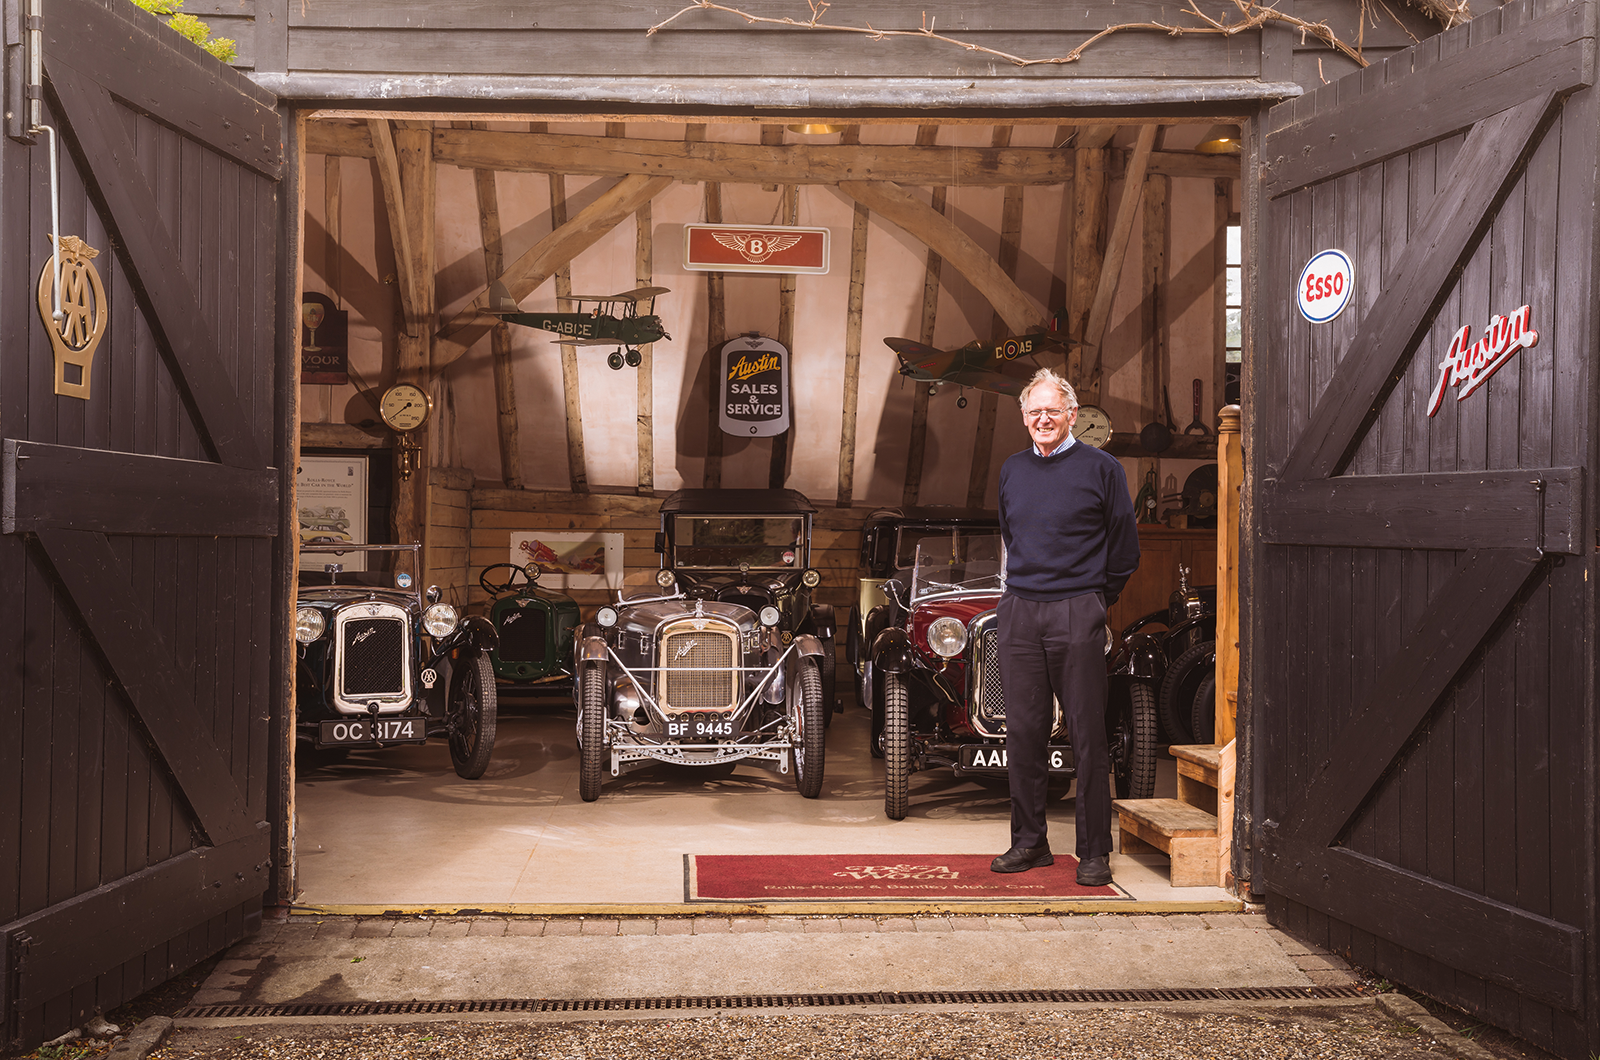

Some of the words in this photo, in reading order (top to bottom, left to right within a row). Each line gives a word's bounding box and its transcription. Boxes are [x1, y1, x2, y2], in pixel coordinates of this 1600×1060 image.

[750, 240, 763, 254] B
[1305, 271, 1344, 302] ESSO
[1019, 340, 1033, 355] AS
[301, 355, 340, 365] VOUR
[728, 353, 781, 381] Austin
[1427, 304, 1539, 418] Austin
[731, 383, 778, 395] SALES
[749, 395, 759, 404] &
[727, 403, 781, 416] SERVICE
[332, 722, 363, 741] OC
[369, 720, 414, 740] 3174
[668, 723, 689, 736] BF
[696, 722, 733, 735] 9445
[833, 871, 960, 880] Wood
